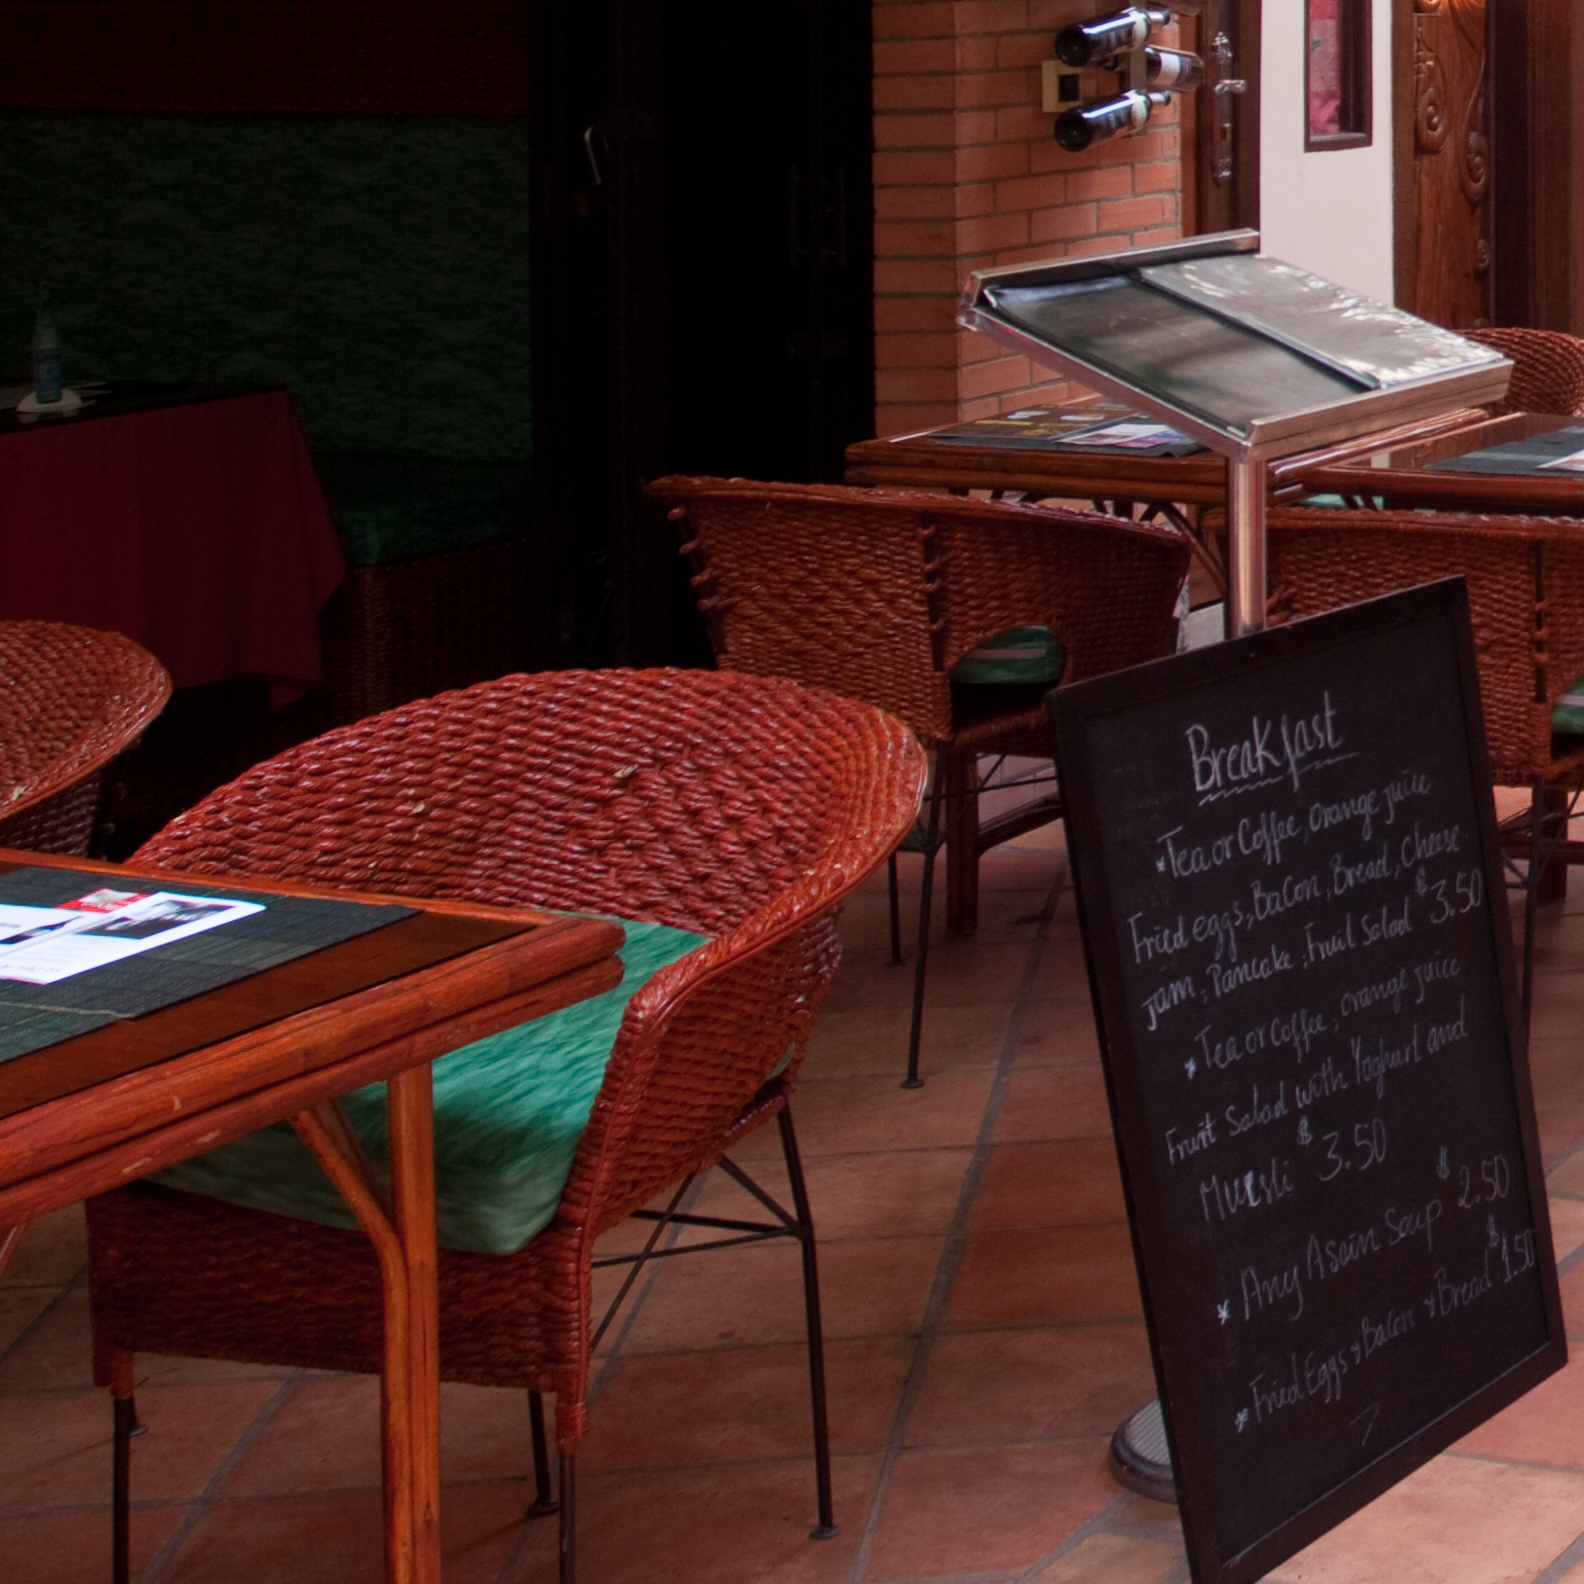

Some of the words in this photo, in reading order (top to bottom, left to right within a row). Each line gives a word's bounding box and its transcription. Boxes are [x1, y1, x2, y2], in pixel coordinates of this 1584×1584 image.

[1156, 826, 1212, 879] Tea
[1212, 832, 1236, 867] or
[1128, 912, 1189, 964] Fried
[1361, 896, 1413, 948] Salad
[1194, 1023, 1243, 1071] Tea
[1245, 1027, 1267, 1054] or
[1340, 967, 1408, 1018] orange
[1225, 1079, 1289, 1138] Salad
[1295, 1056, 1349, 1109] with
[1350, 1022, 1422, 1101] Yoghurt
[1426, 996, 1469, 1055] and
[1199, 1157, 1294, 1222] Muesli
[1240, 1265, 1304, 1322] Any
[1384, 1198, 1443, 1253] Soup
[1248, 1354, 1305, 1423] Fried
[1305, 1350, 1349, 1405] Eggs
[1434, 1249, 1493, 1316] Bread
